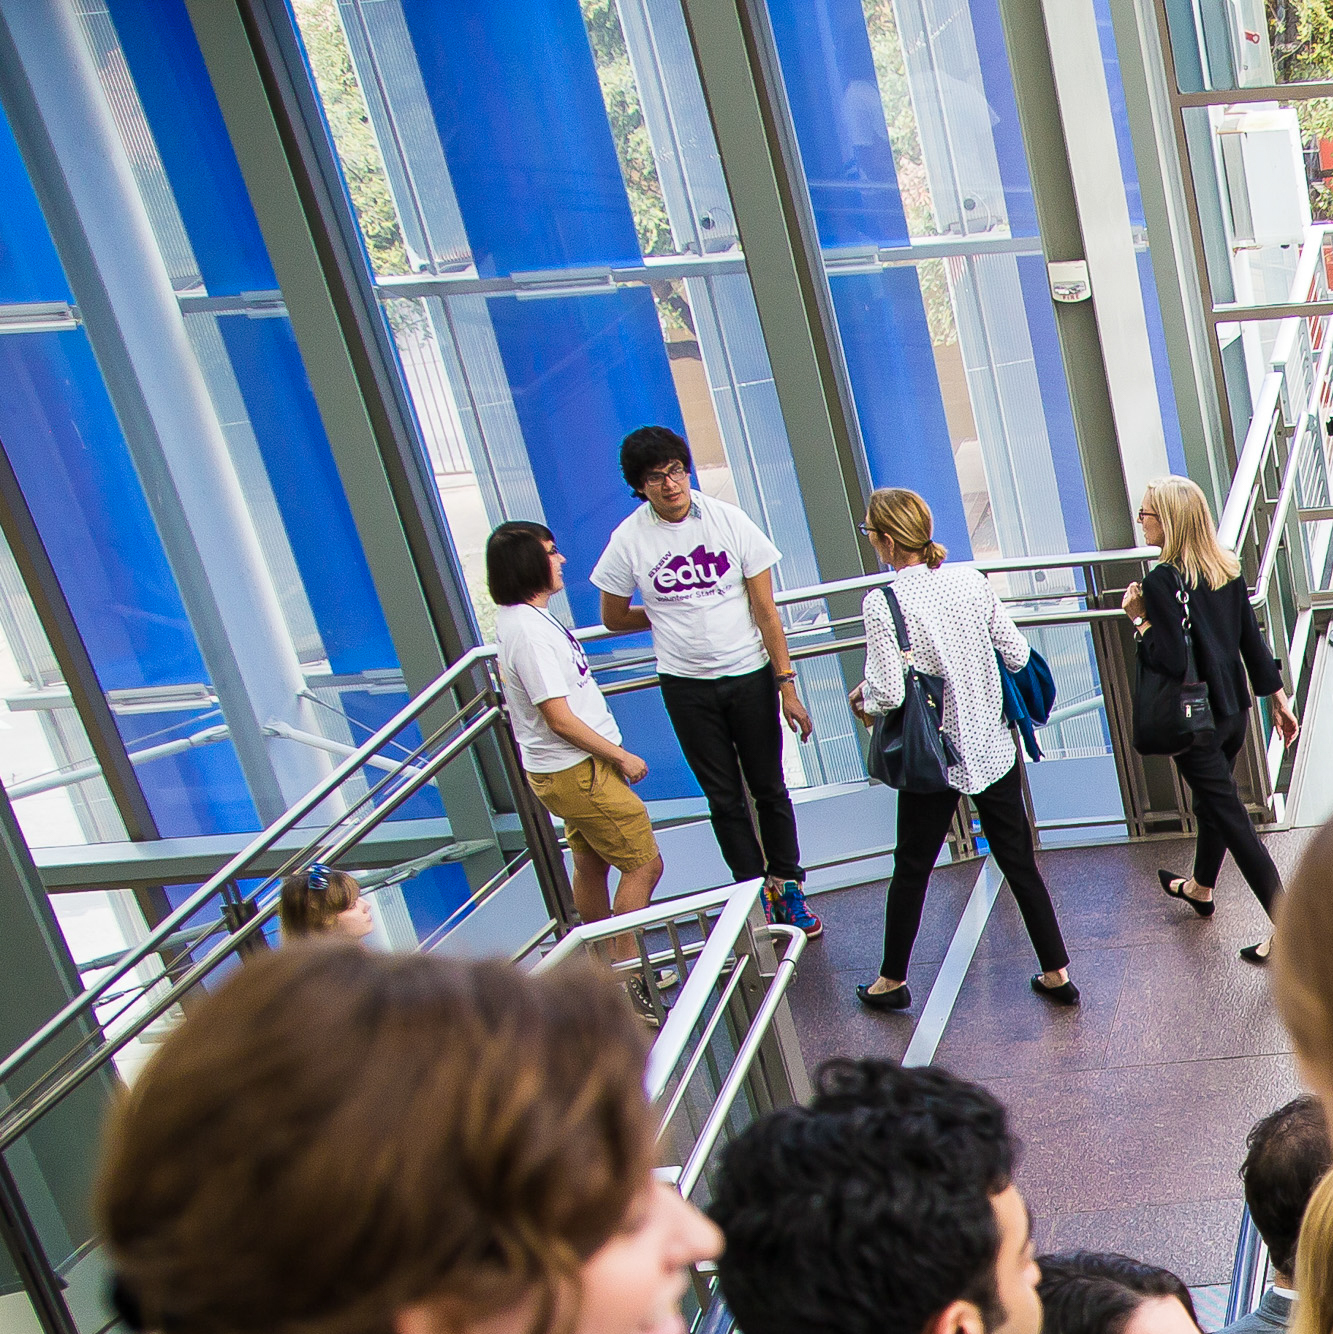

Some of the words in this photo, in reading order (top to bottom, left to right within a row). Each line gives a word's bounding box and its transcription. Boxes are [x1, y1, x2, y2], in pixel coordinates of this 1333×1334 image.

[648, 551, 672, 578] SXSW
[657, 556, 718, 588] edu
[695, 590, 716, 599] Staff
